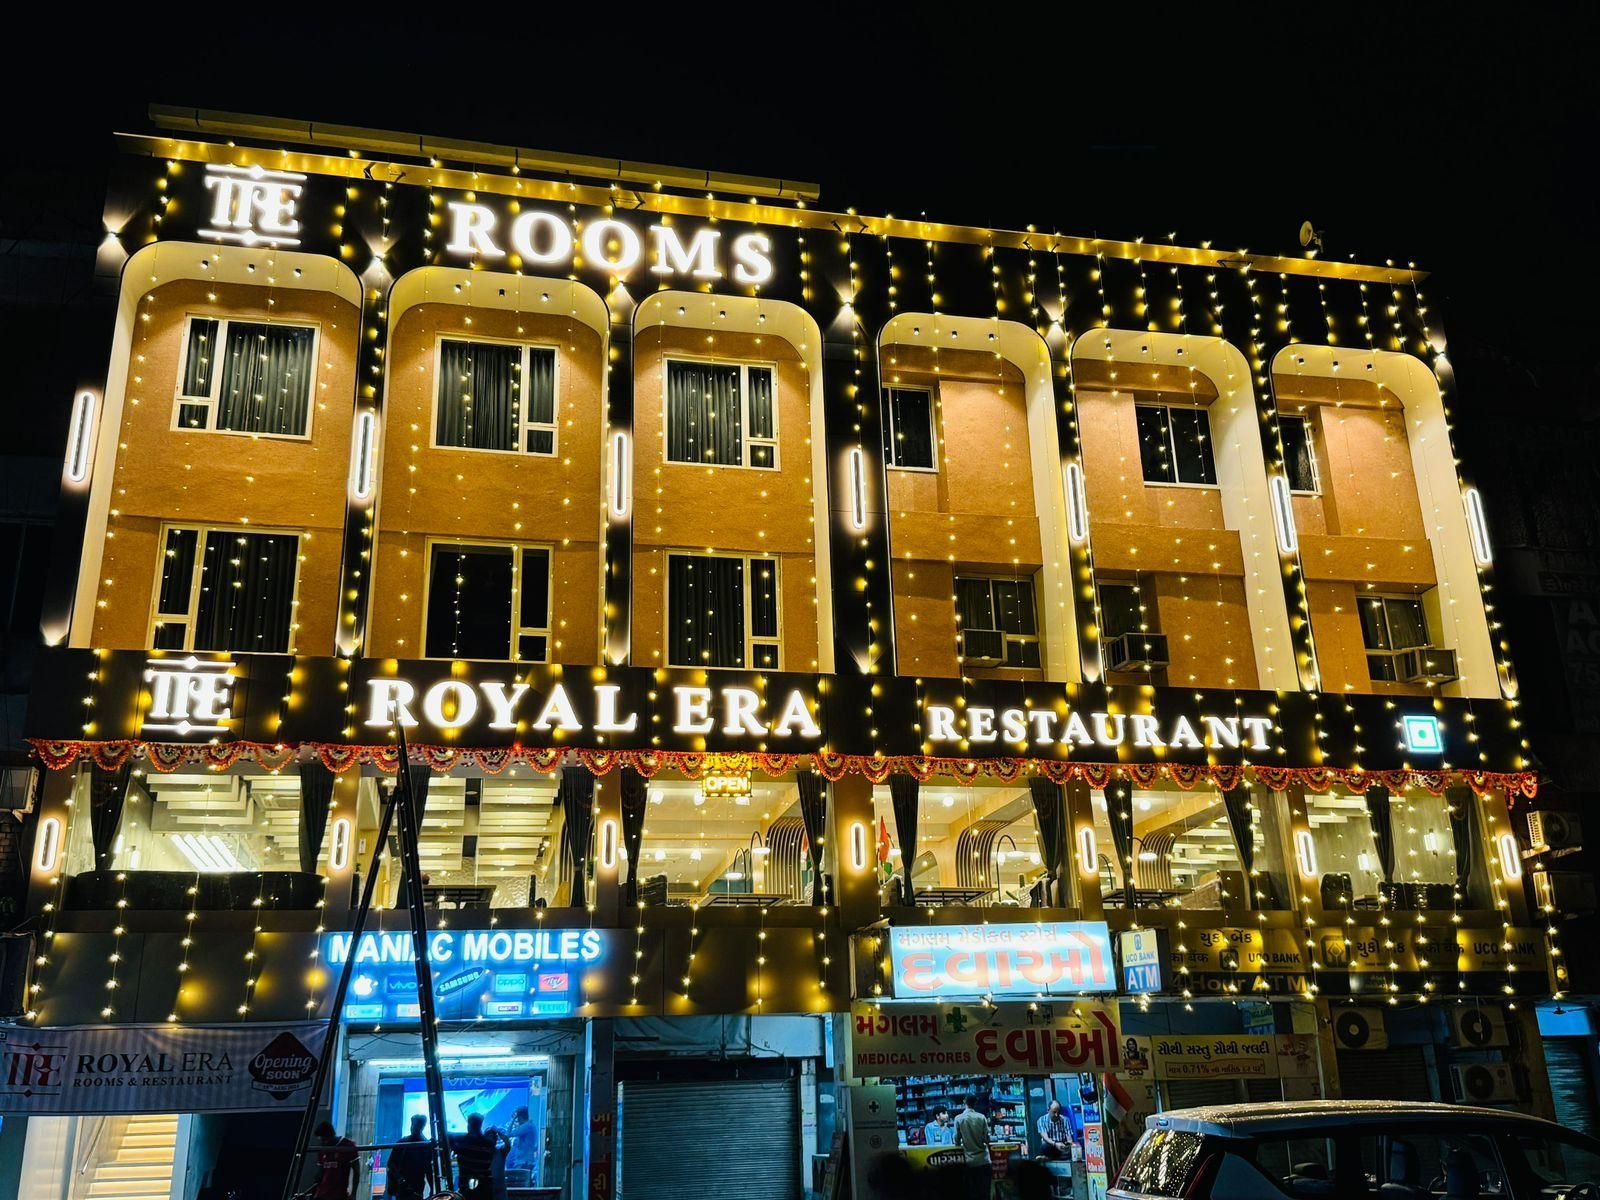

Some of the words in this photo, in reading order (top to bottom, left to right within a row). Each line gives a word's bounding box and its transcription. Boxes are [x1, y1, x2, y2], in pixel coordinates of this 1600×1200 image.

[446, 200, 773, 284] ROOMS
[365, 679, 638, 733] ROYAL
[673, 685, 821, 737] ERA
[926, 705, 1275, 752] RESTAURANT
[706, 776, 748, 791] OPEN
[463, 930, 601, 962] MOBILES
[1125, 952, 1138, 963] UCO
[1138, 950, 1157, 961] BANK
[1474, 942, 1499, 954] UCO
[1503, 942, 1537, 955] ANK
[901, 930, 1108, 991] દવાઓ
[1248, 952, 1270, 963] UCO
[1272, 952, 1300, 963] BANK
[438, 971, 481, 992] SAMSUNG
[1127, 965, 1158, 990] ATM
[1251, 974, 1309, 992] ATM
[855, 1011, 942, 1045] મંગલમ્
[974, 1009, 1120, 1068] દવાઓ
[75, 1052, 175, 1074] ROYAL
[180, 1050, 234, 1072] ERA
[254, 1053, 313, 1075] Opening
[857, 1052, 916, 1065] MEDICAL
[920, 1051, 971, 1064] STORES
[73, 1076, 123, 1088] ROOMS
[127, 1077, 137, 1087] &
[141, 1074, 233, 1087] RESTAURANT
[265, 1069, 301, 1080] SOON
